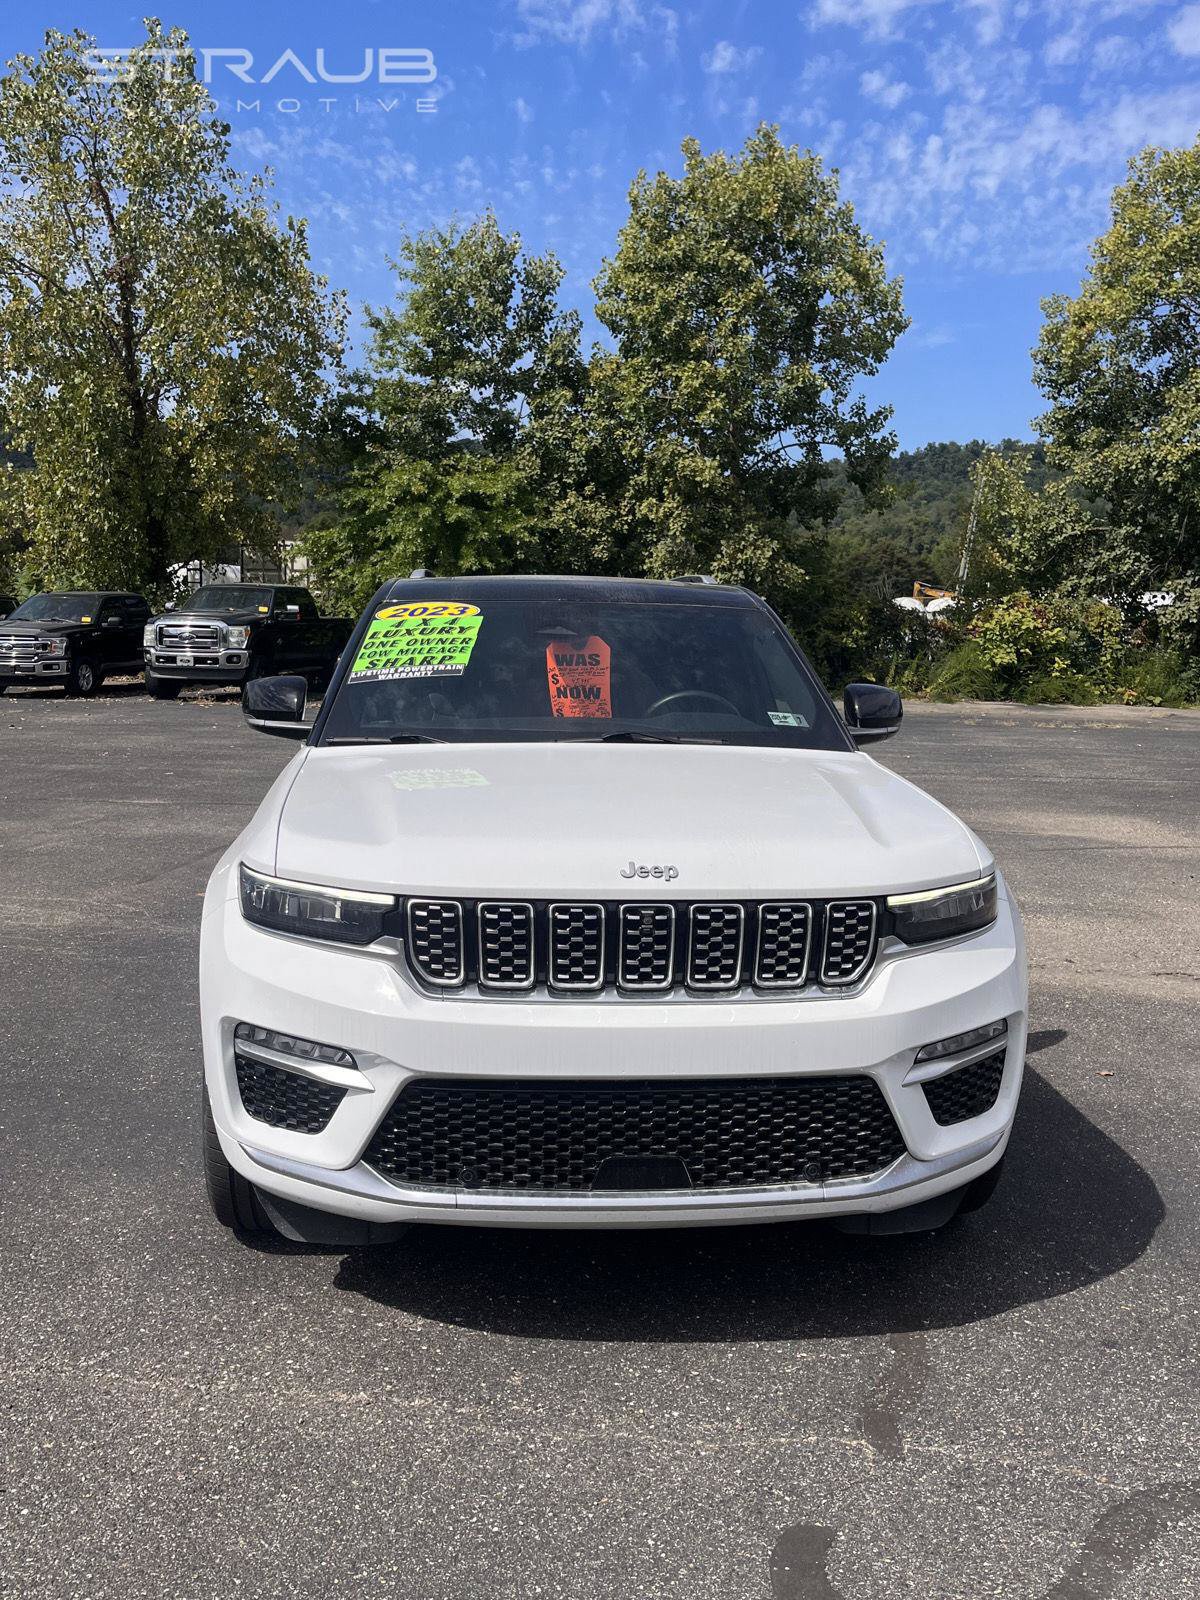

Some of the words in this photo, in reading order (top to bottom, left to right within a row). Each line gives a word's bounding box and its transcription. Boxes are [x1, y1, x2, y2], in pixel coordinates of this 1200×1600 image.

[387, 606, 470, 618] 2023
[389, 619, 407, 628] 4
[416, 617, 434, 627] X
[444, 616, 460, 626] 4
[368, 626, 475, 640] LUXURY
[363, 640, 402, 650] ONE
[406, 637, 473, 647] OWNER
[359, 650, 391, 660] LOW
[397, 646, 470, 656] MILEAGE
[555, 653, 601, 667] WAS
[365, 655, 454, 670] SHARP
[351, 668, 397, 678] LIFETIME
[397, 664, 463, 673] POWERTRAIN
[378, 671, 434, 680] WARRANTY
[556, 687, 602, 699] NOW
[620, 861, 679, 881] Jeep
